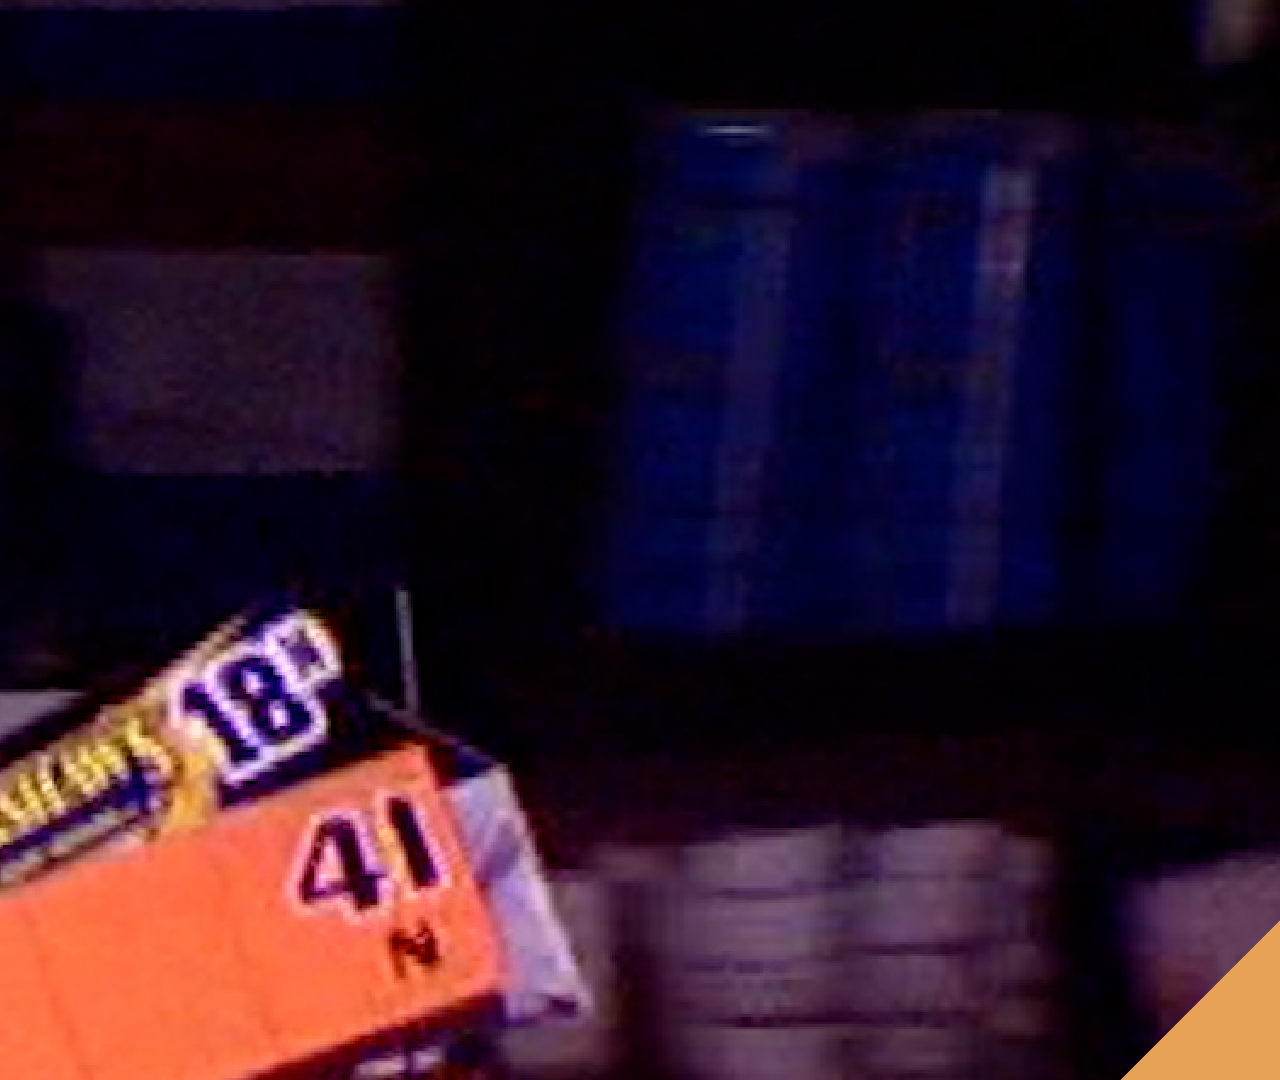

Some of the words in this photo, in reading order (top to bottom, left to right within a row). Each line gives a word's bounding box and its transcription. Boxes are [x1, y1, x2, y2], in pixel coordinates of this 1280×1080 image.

[173, 648, 322, 778] 18
[292, 792, 444, 915] 41
[386, 916, 444, 980] N
